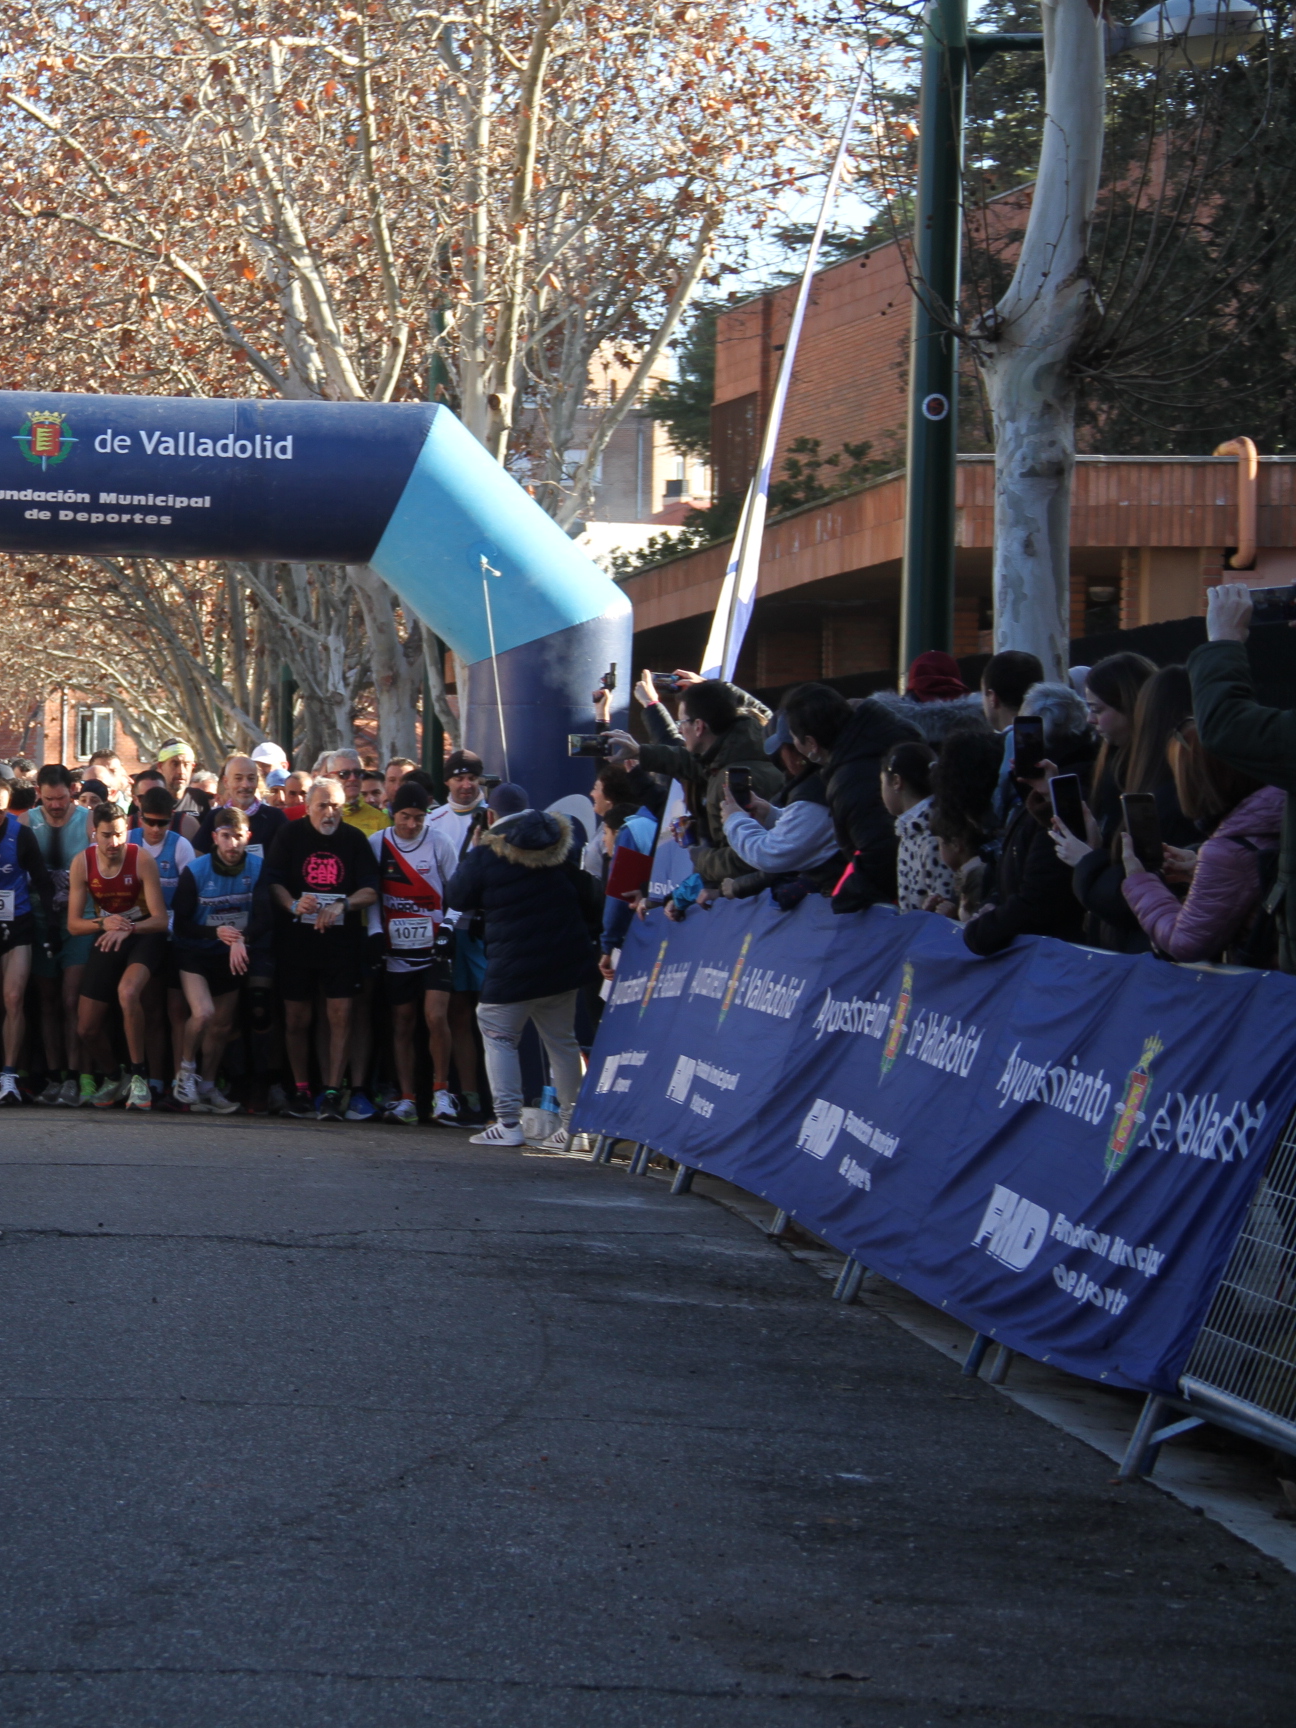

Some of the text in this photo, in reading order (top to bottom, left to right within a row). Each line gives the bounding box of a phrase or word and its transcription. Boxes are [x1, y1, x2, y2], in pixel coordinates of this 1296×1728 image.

[94, 428, 132, 454] de
[138, 430, 295, 460] Valladolid
[98, 491, 212, 509] Municipal
[24, 508, 173, 525] de Deportes
[394, 925, 428, 940] 1077
